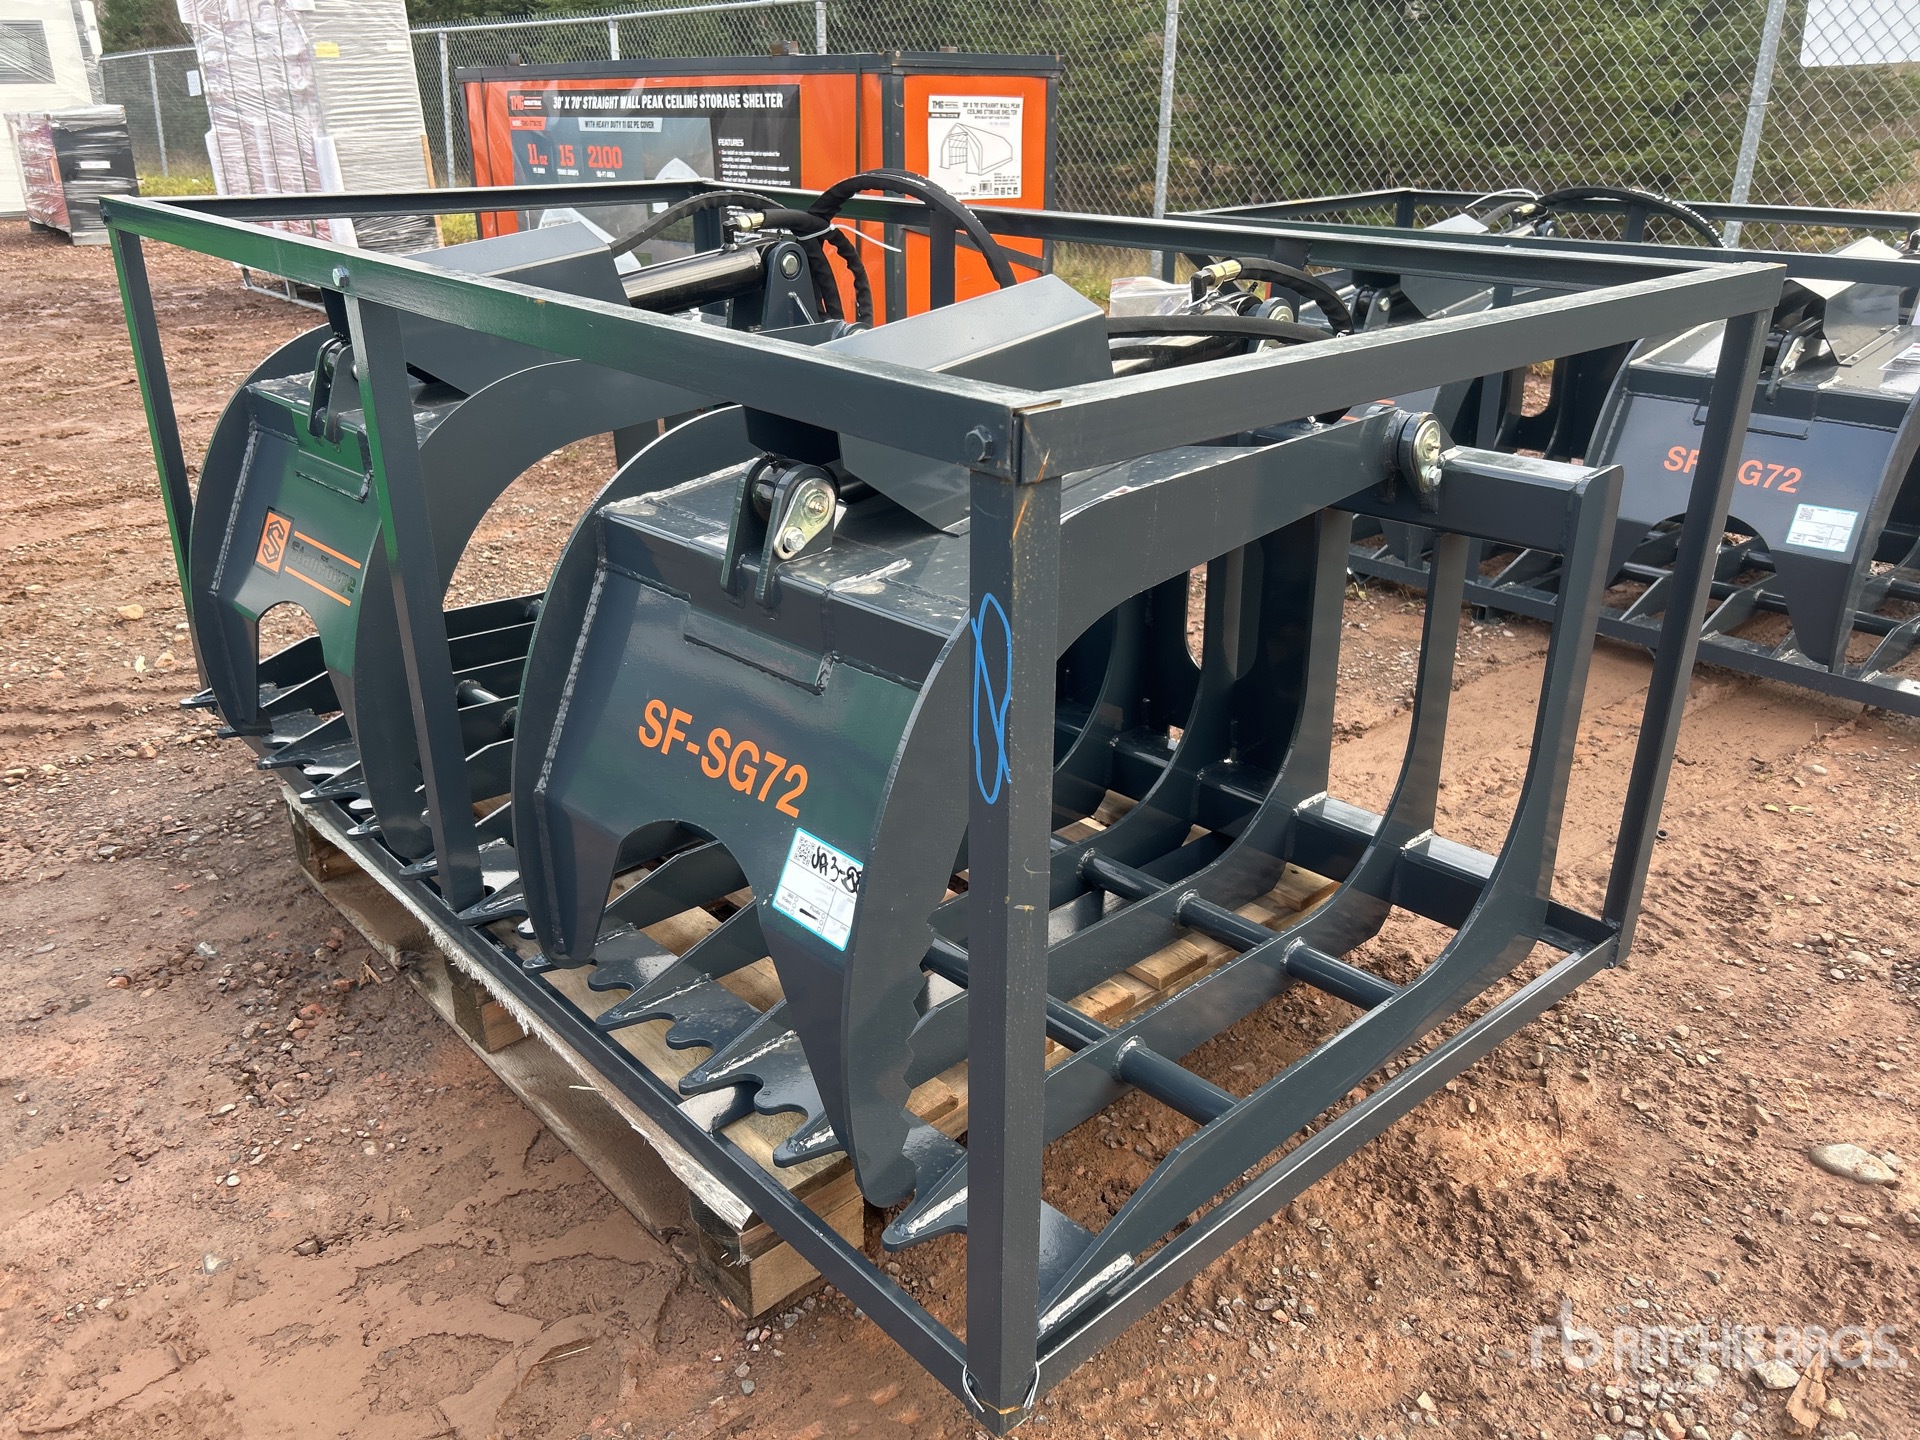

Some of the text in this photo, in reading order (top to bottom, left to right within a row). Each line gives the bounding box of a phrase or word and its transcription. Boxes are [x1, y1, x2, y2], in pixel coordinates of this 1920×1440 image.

[553, 92, 784, 110] 30' X 70' STRAIGHT WALL PEAK CEILING STORAGE SHELTER
[527, 143, 540, 165] 11
[559, 144, 575, 167] 15
[587, 145, 623, 169] 2100
[638, 698, 809, 819] SF-SG72
